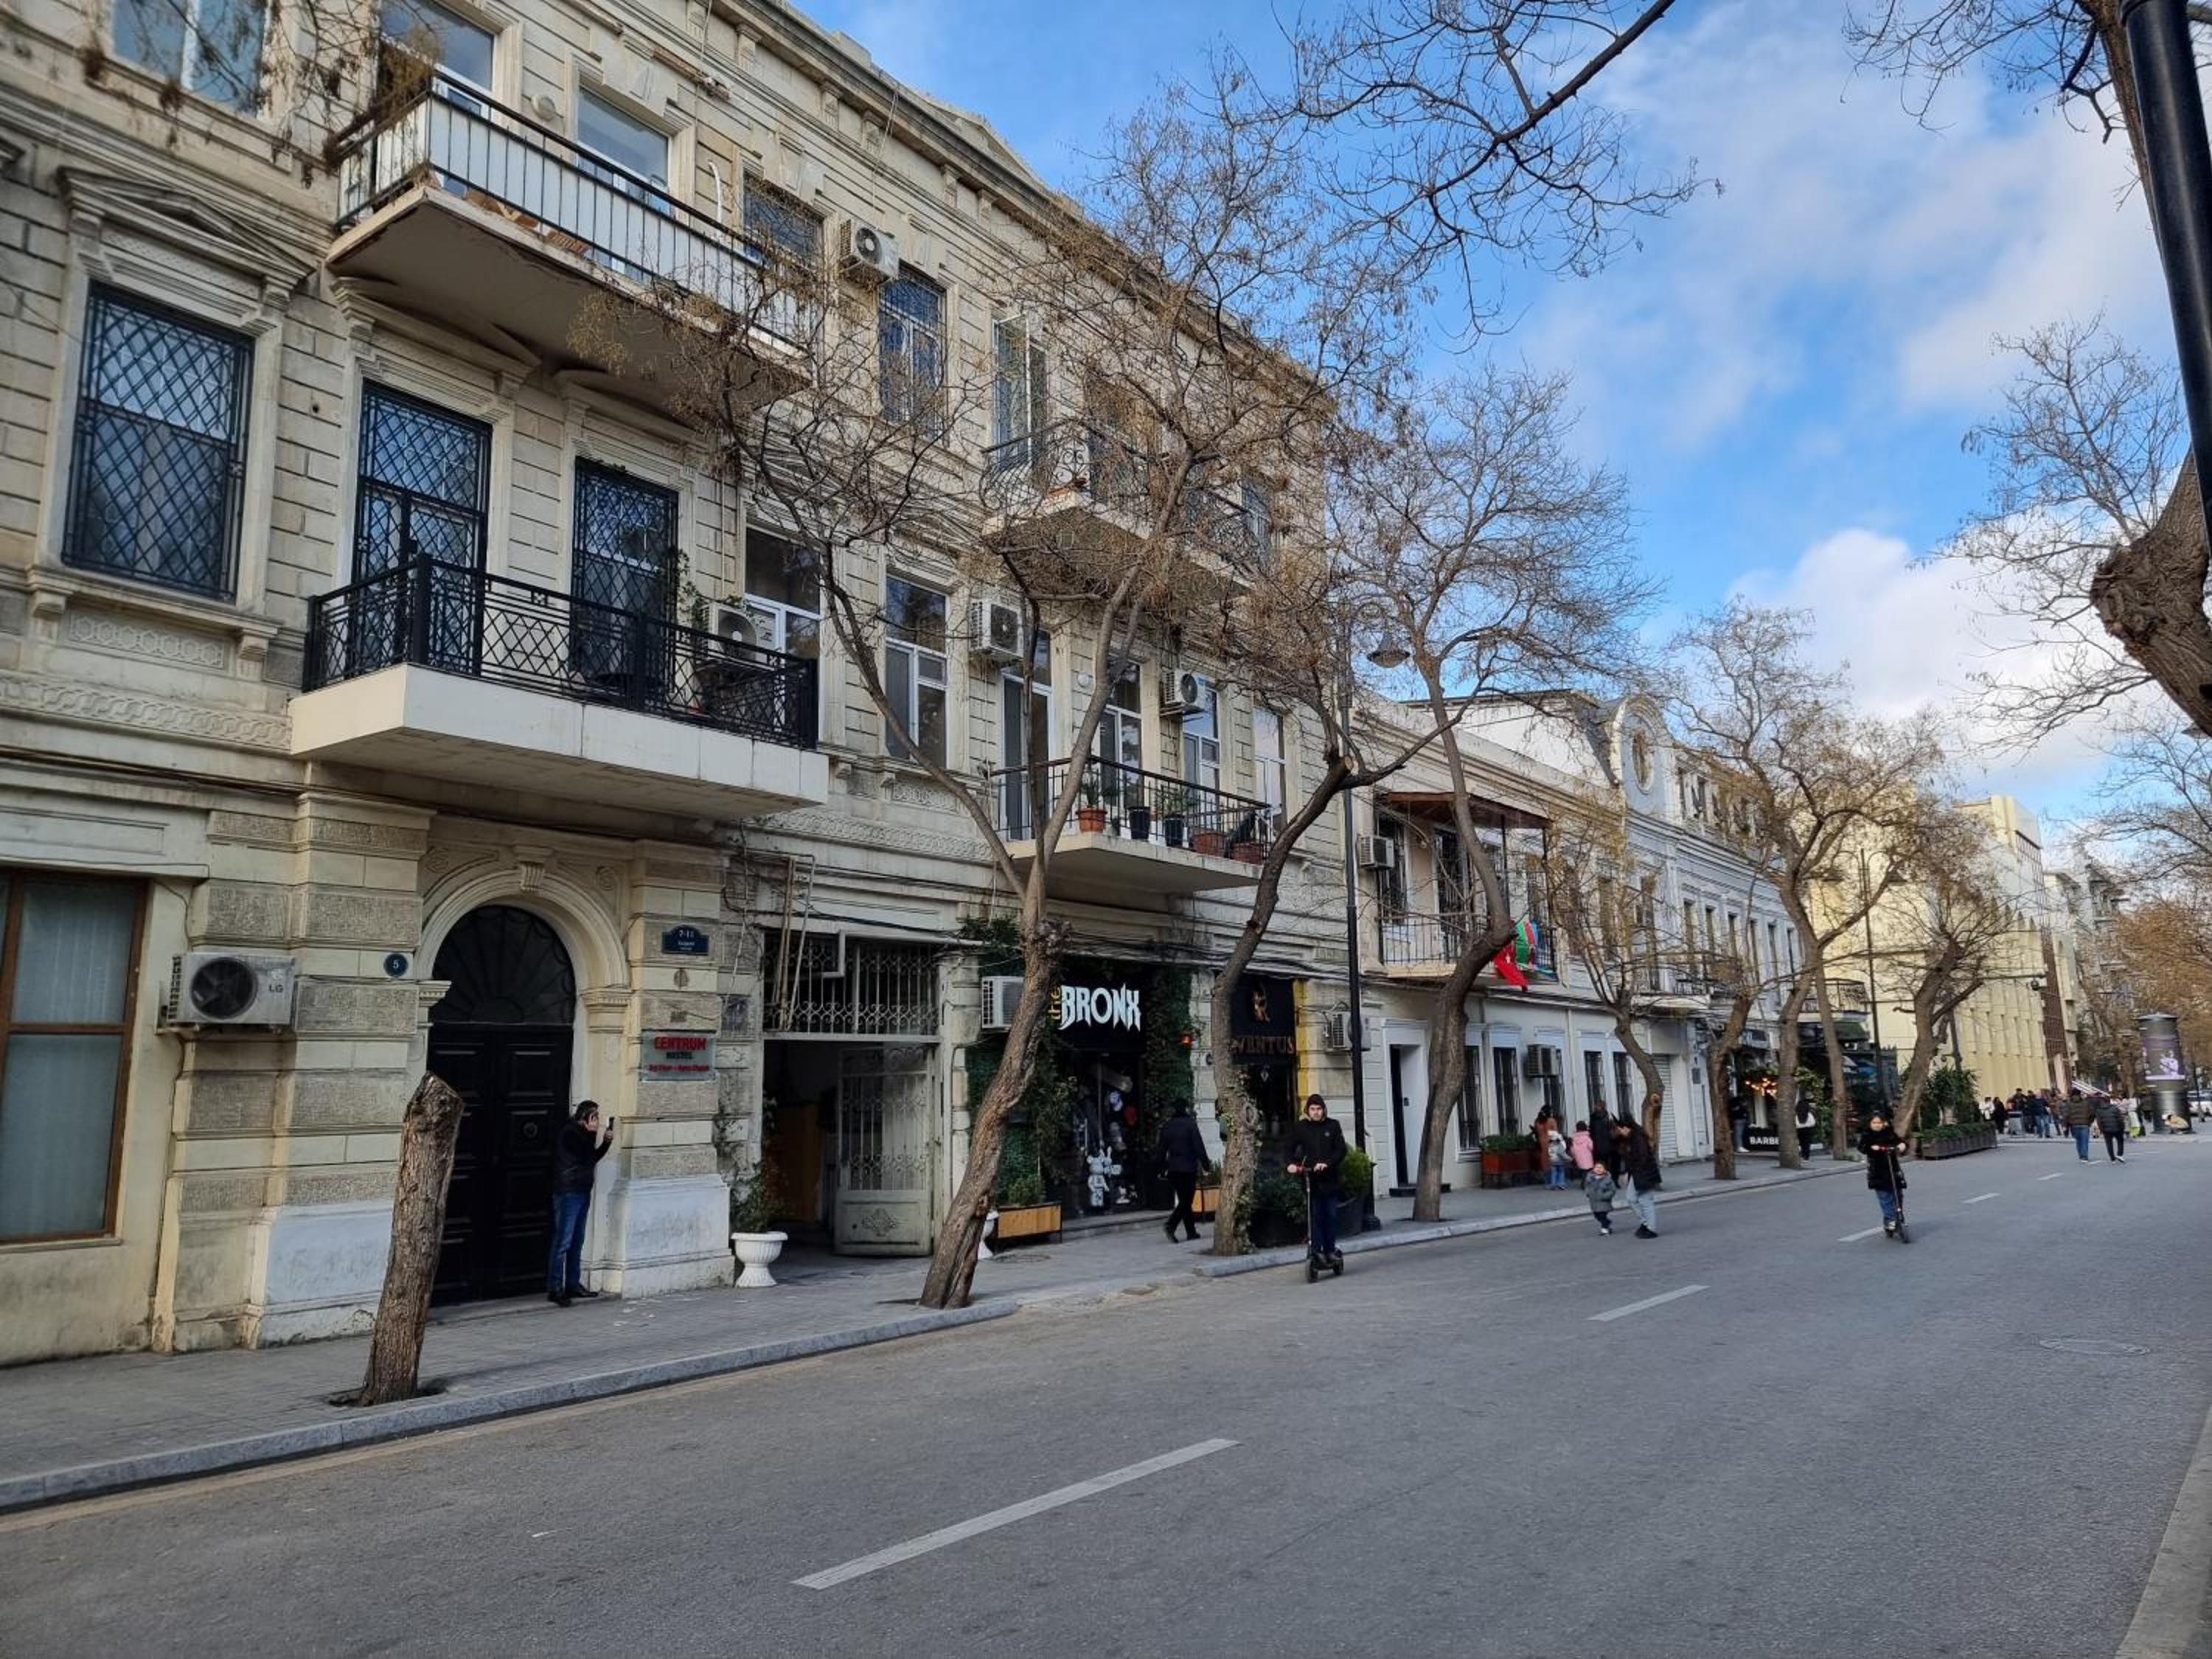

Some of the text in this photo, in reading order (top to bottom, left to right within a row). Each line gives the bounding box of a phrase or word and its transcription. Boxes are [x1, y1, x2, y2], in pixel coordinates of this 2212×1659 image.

[393, 959, 399, 969] 5
[269, 984, 284, 992] LG
[1048, 983, 1141, 1032] the BRONX
[654, 1037, 707, 1050] CENTRUM
